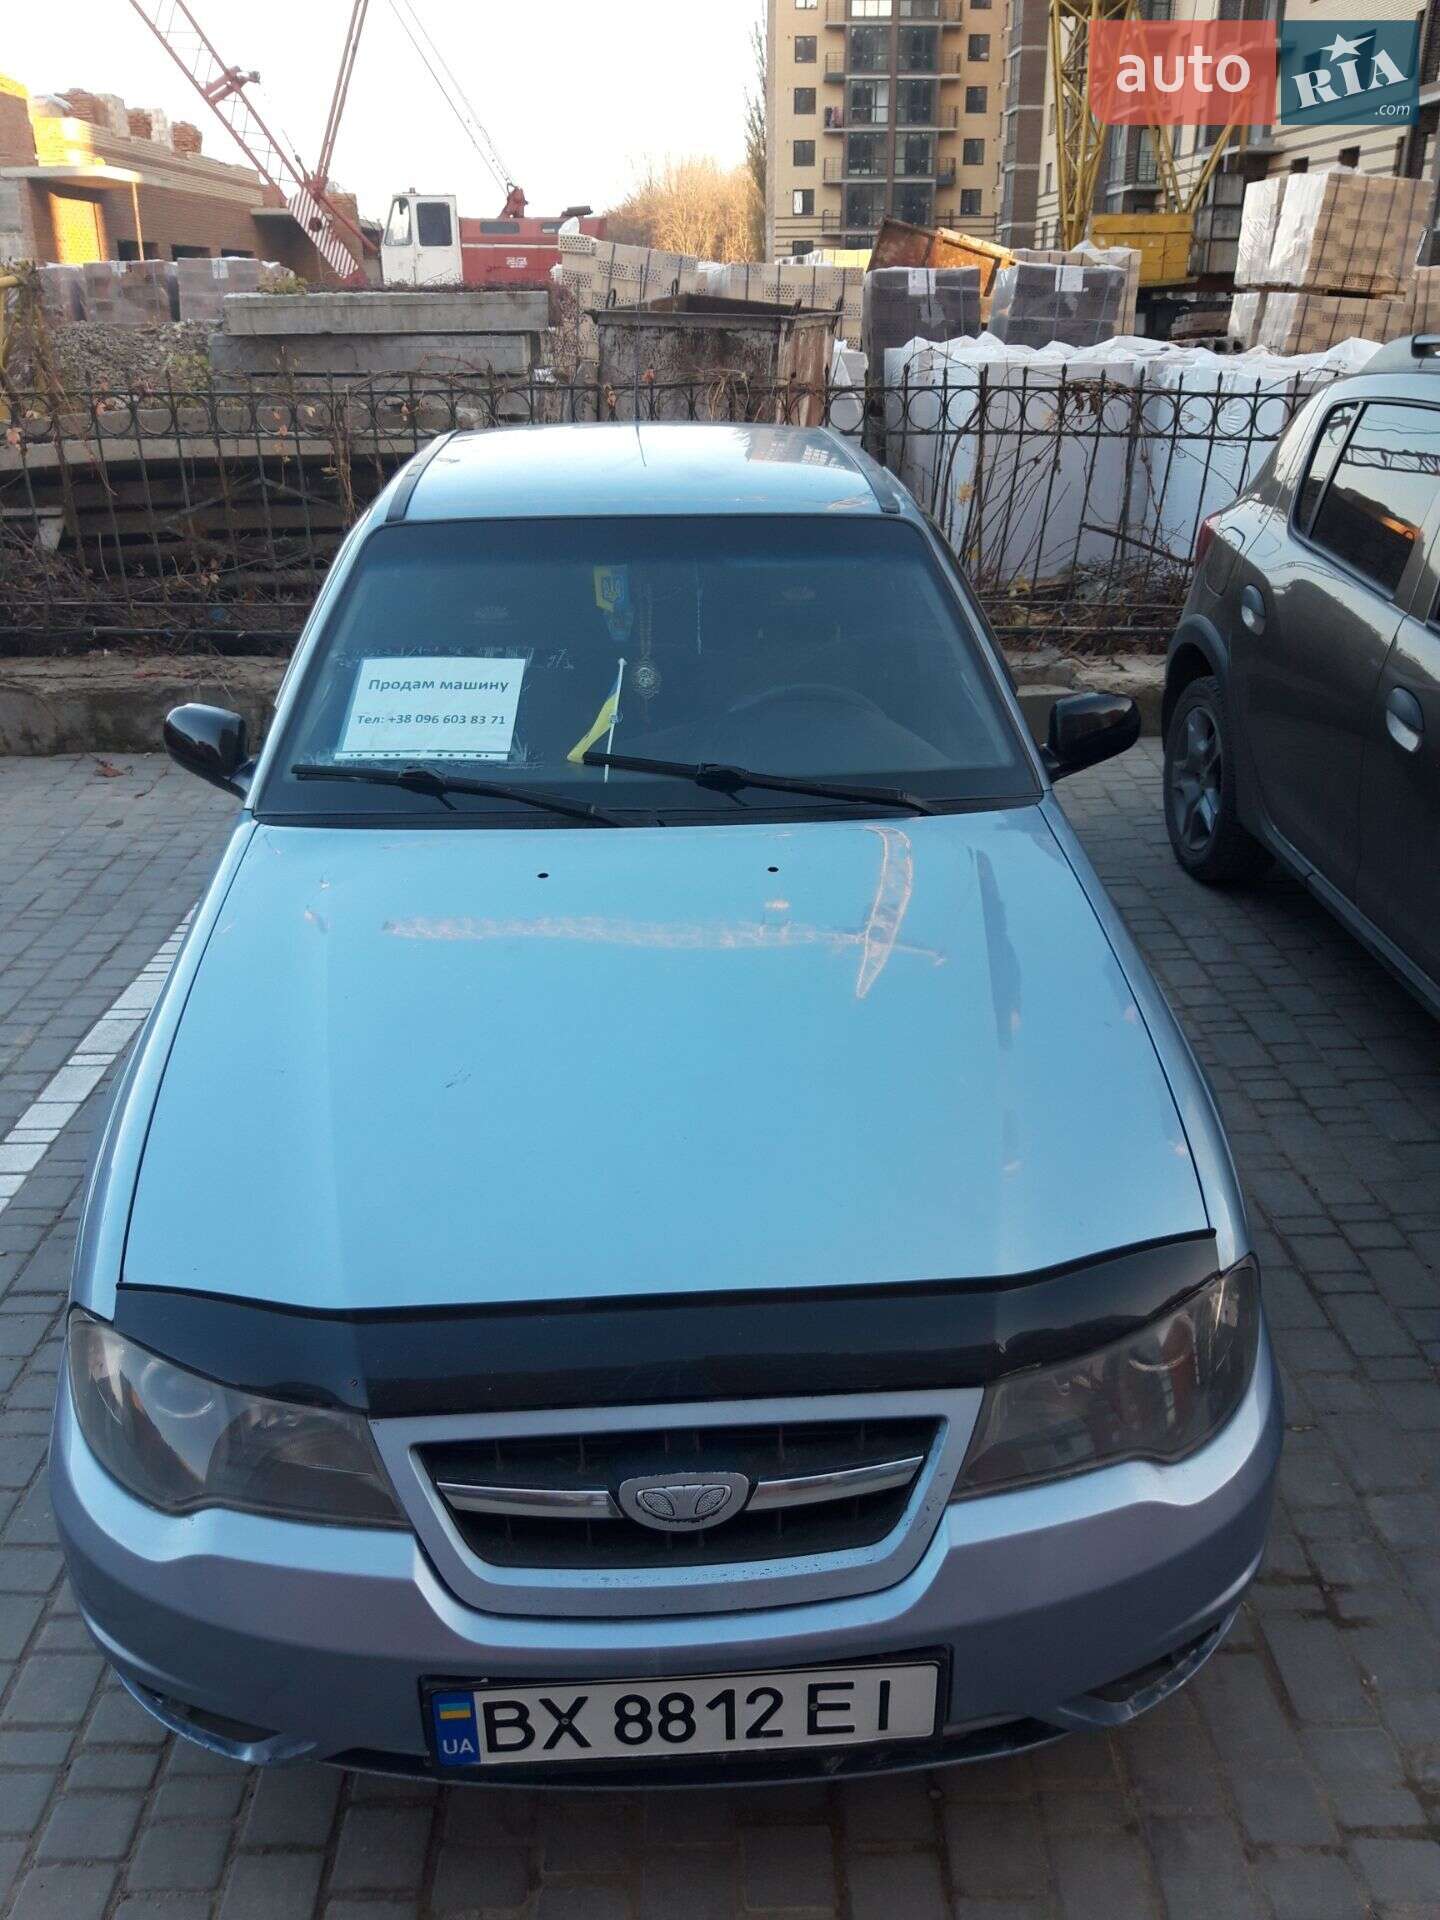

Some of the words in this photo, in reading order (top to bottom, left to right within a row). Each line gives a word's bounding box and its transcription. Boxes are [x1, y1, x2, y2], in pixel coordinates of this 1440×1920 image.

[368, 679, 435, 692] Продам
[440, 680, 509, 693] машину
[357, 715, 385, 724] Тел:
[388, 714, 412, 724] +38
[415, 714, 440, 724] 096
[443, 714, 467, 724] 603
[470, 715, 486, 725] 83
[491, 715, 506, 725] 71
[482, 1696, 592, 1754] BX
[613, 1687, 785, 1746] 8812
[807, 1679, 892, 1735] EI
[442, 1737, 475, 1756] UA
